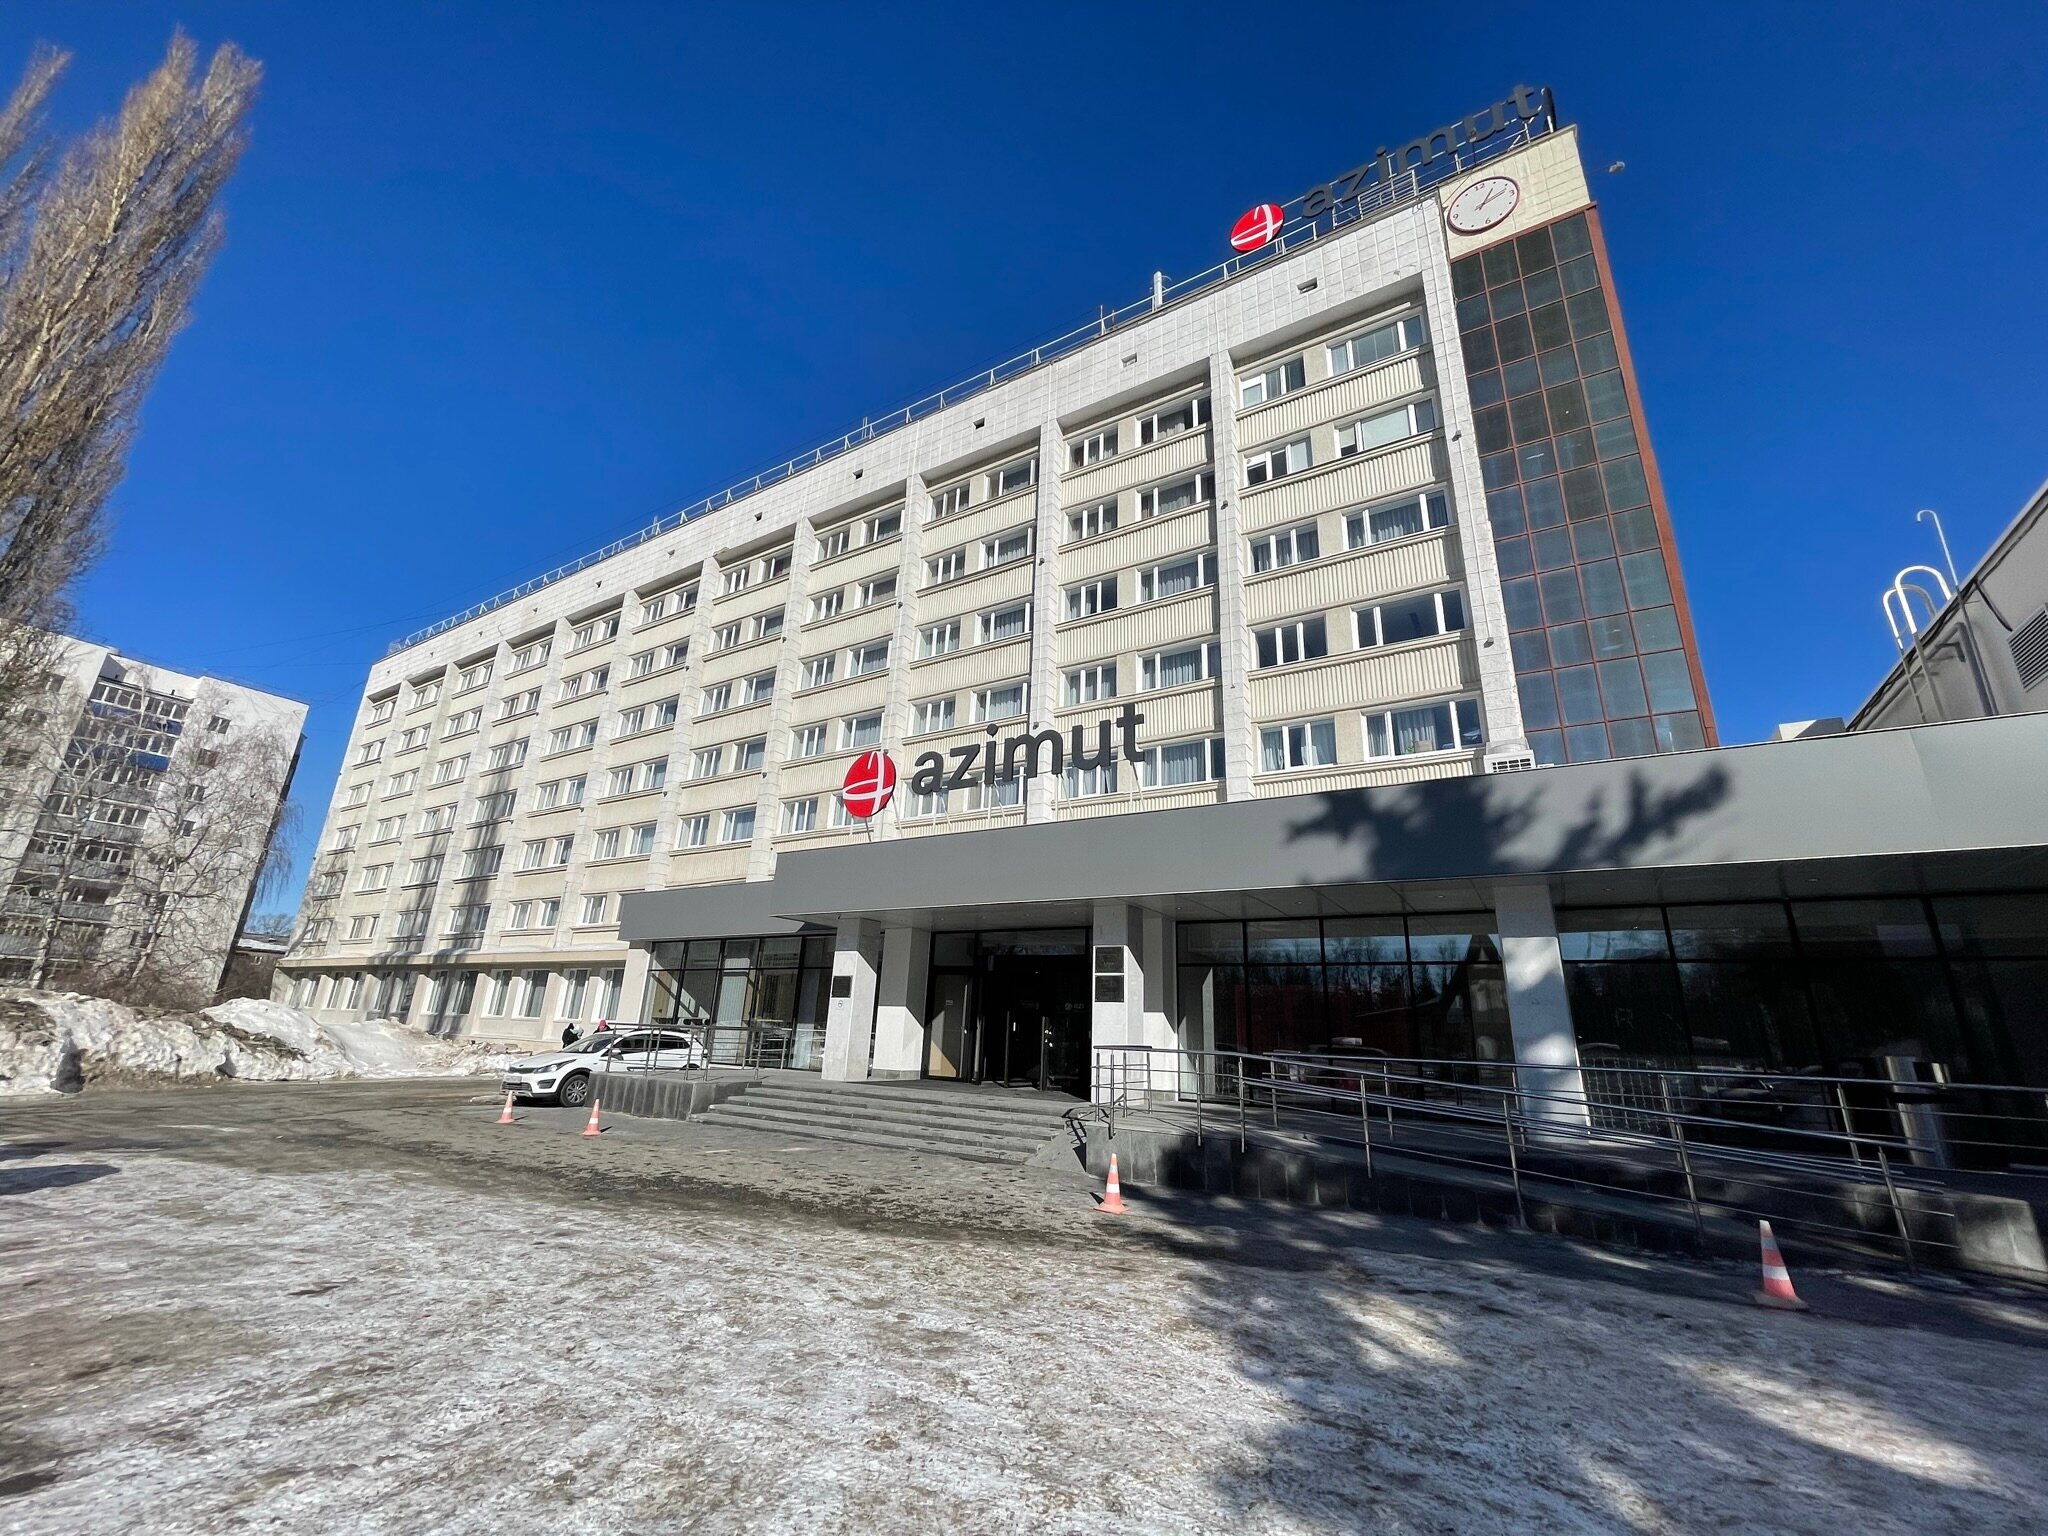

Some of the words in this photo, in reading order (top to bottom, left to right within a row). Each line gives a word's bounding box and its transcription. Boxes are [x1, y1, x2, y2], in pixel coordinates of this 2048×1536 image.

[1302, 83, 1539, 218] azimut
[1474, 183, 1485, 192] 12
[1509, 189, 1515, 197] 3
[1485, 216, 1491, 225] 6
[911, 703, 1146, 796] azimut
